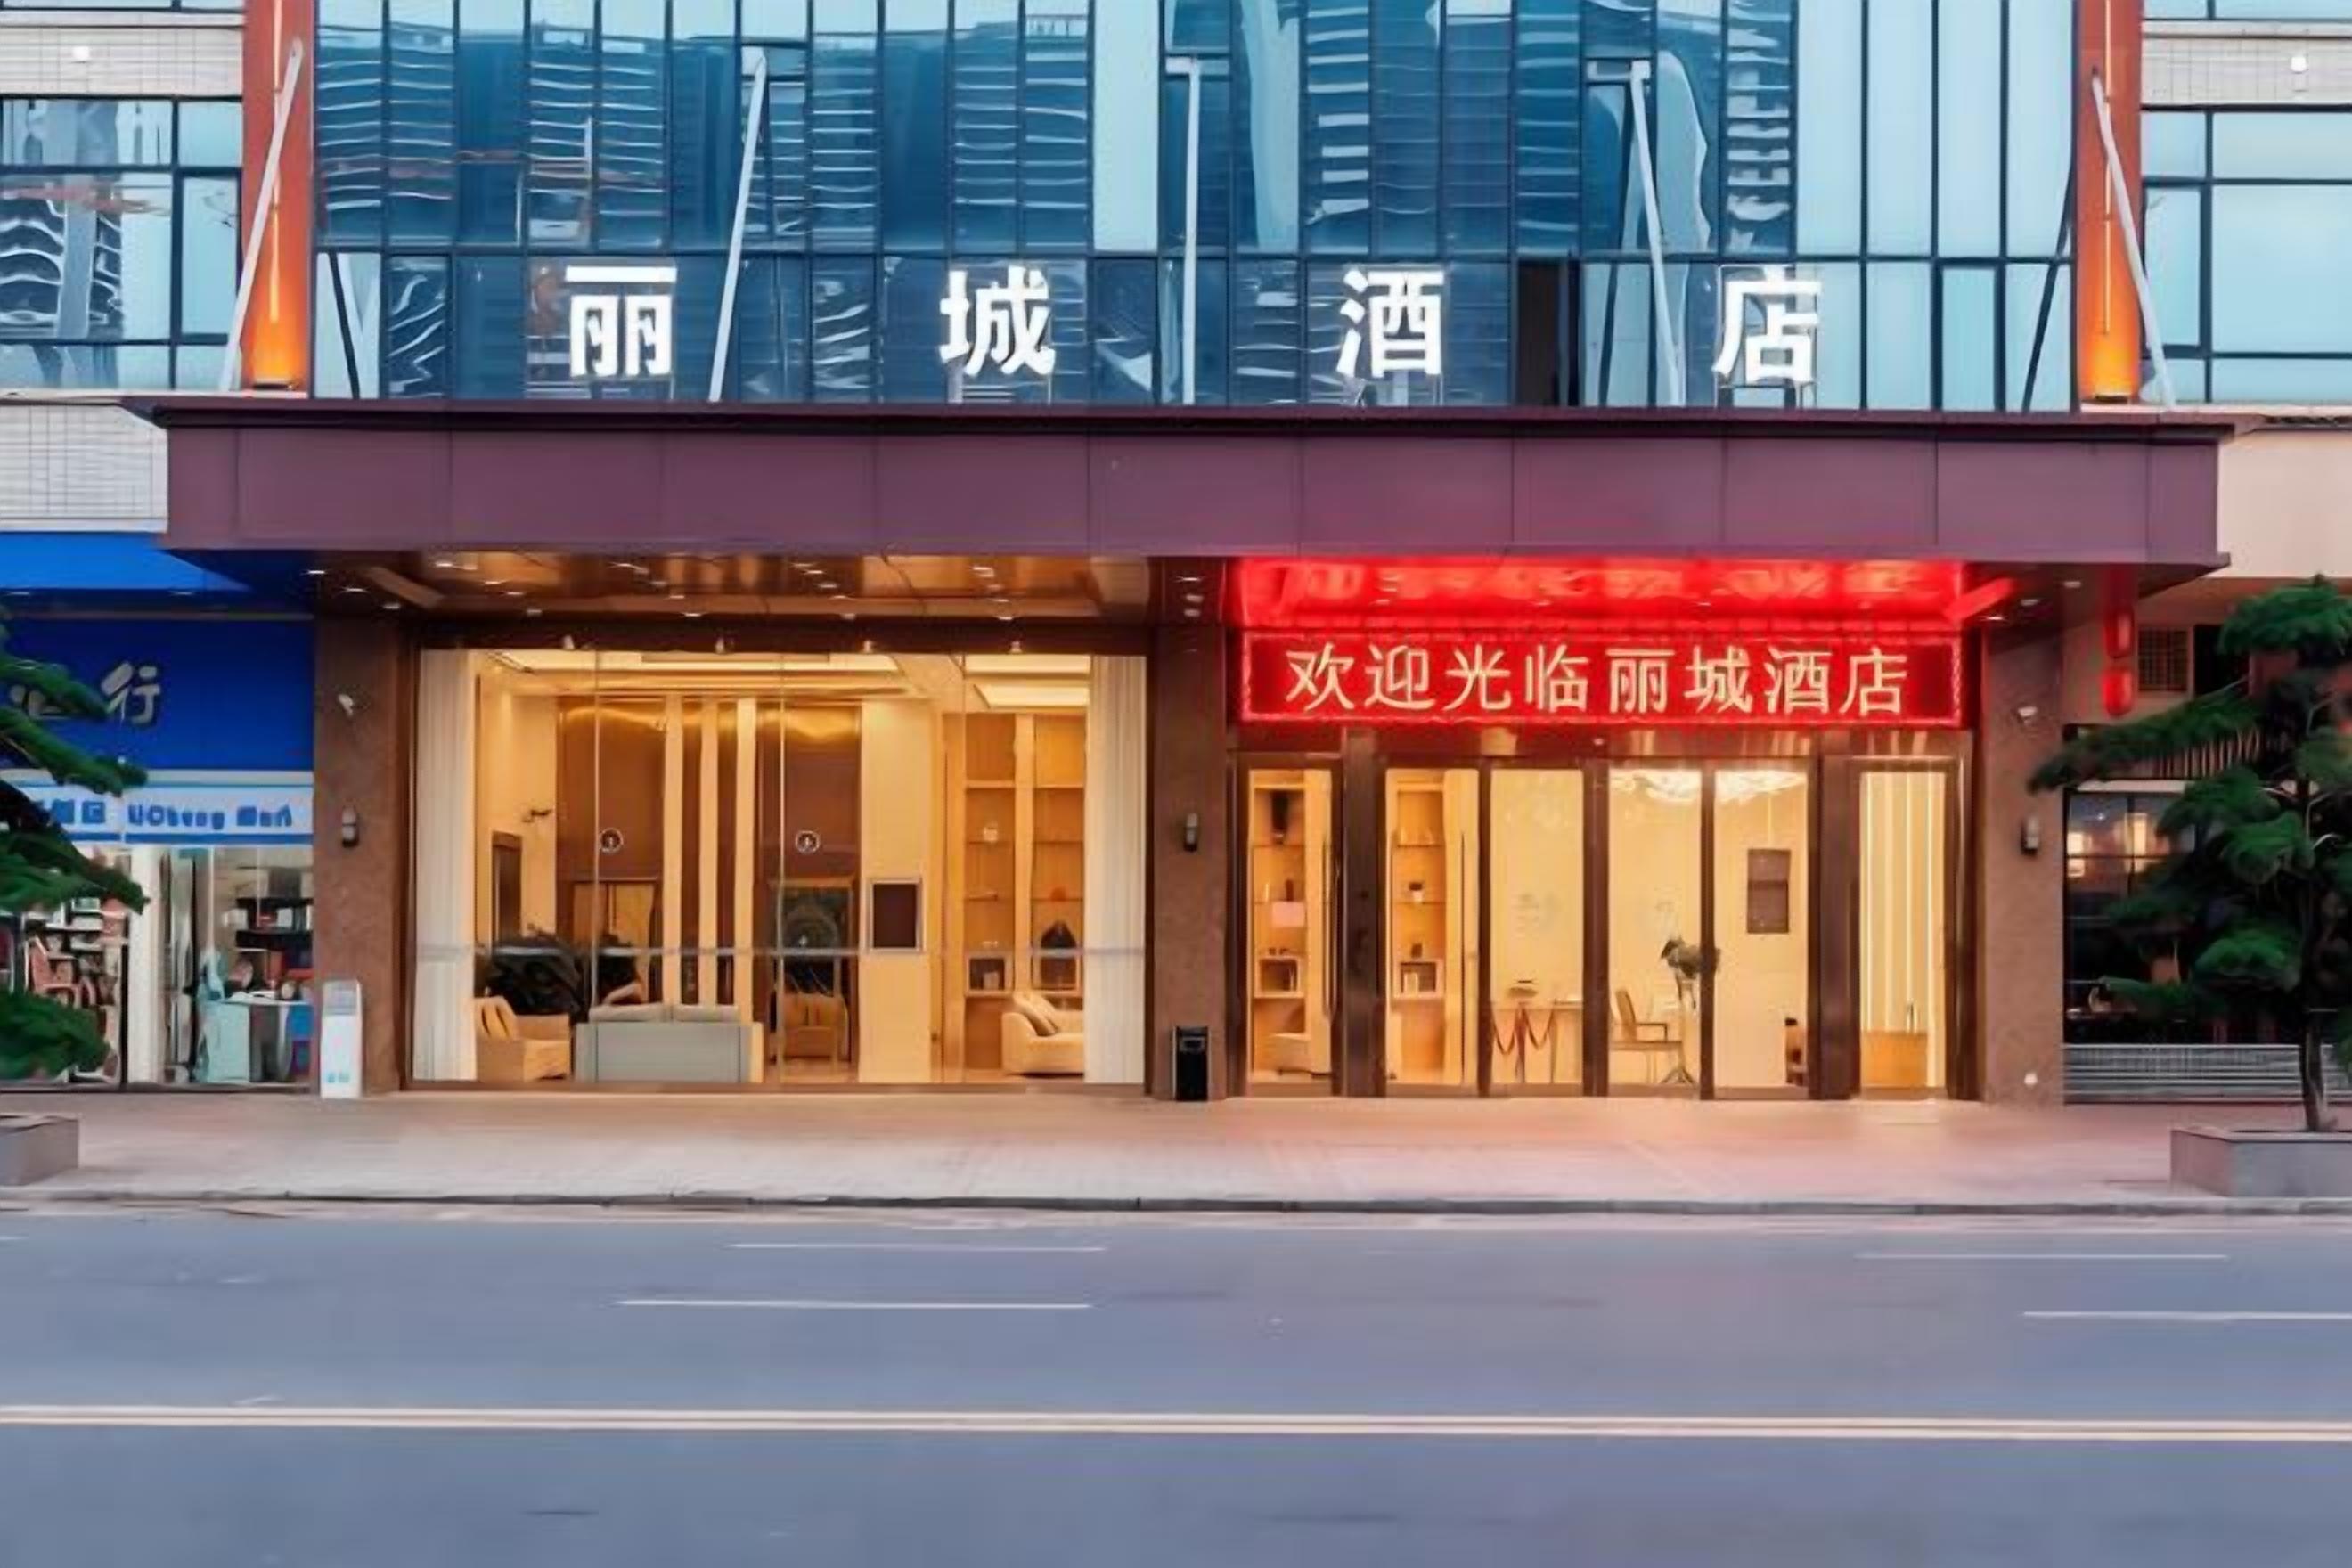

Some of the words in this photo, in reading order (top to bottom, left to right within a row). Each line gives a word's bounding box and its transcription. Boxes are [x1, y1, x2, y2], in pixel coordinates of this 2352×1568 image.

[566, 265, 1821, 384] 丽城酒店
[1285, 642, 1908, 715] 欢迎光临丽城酒店
